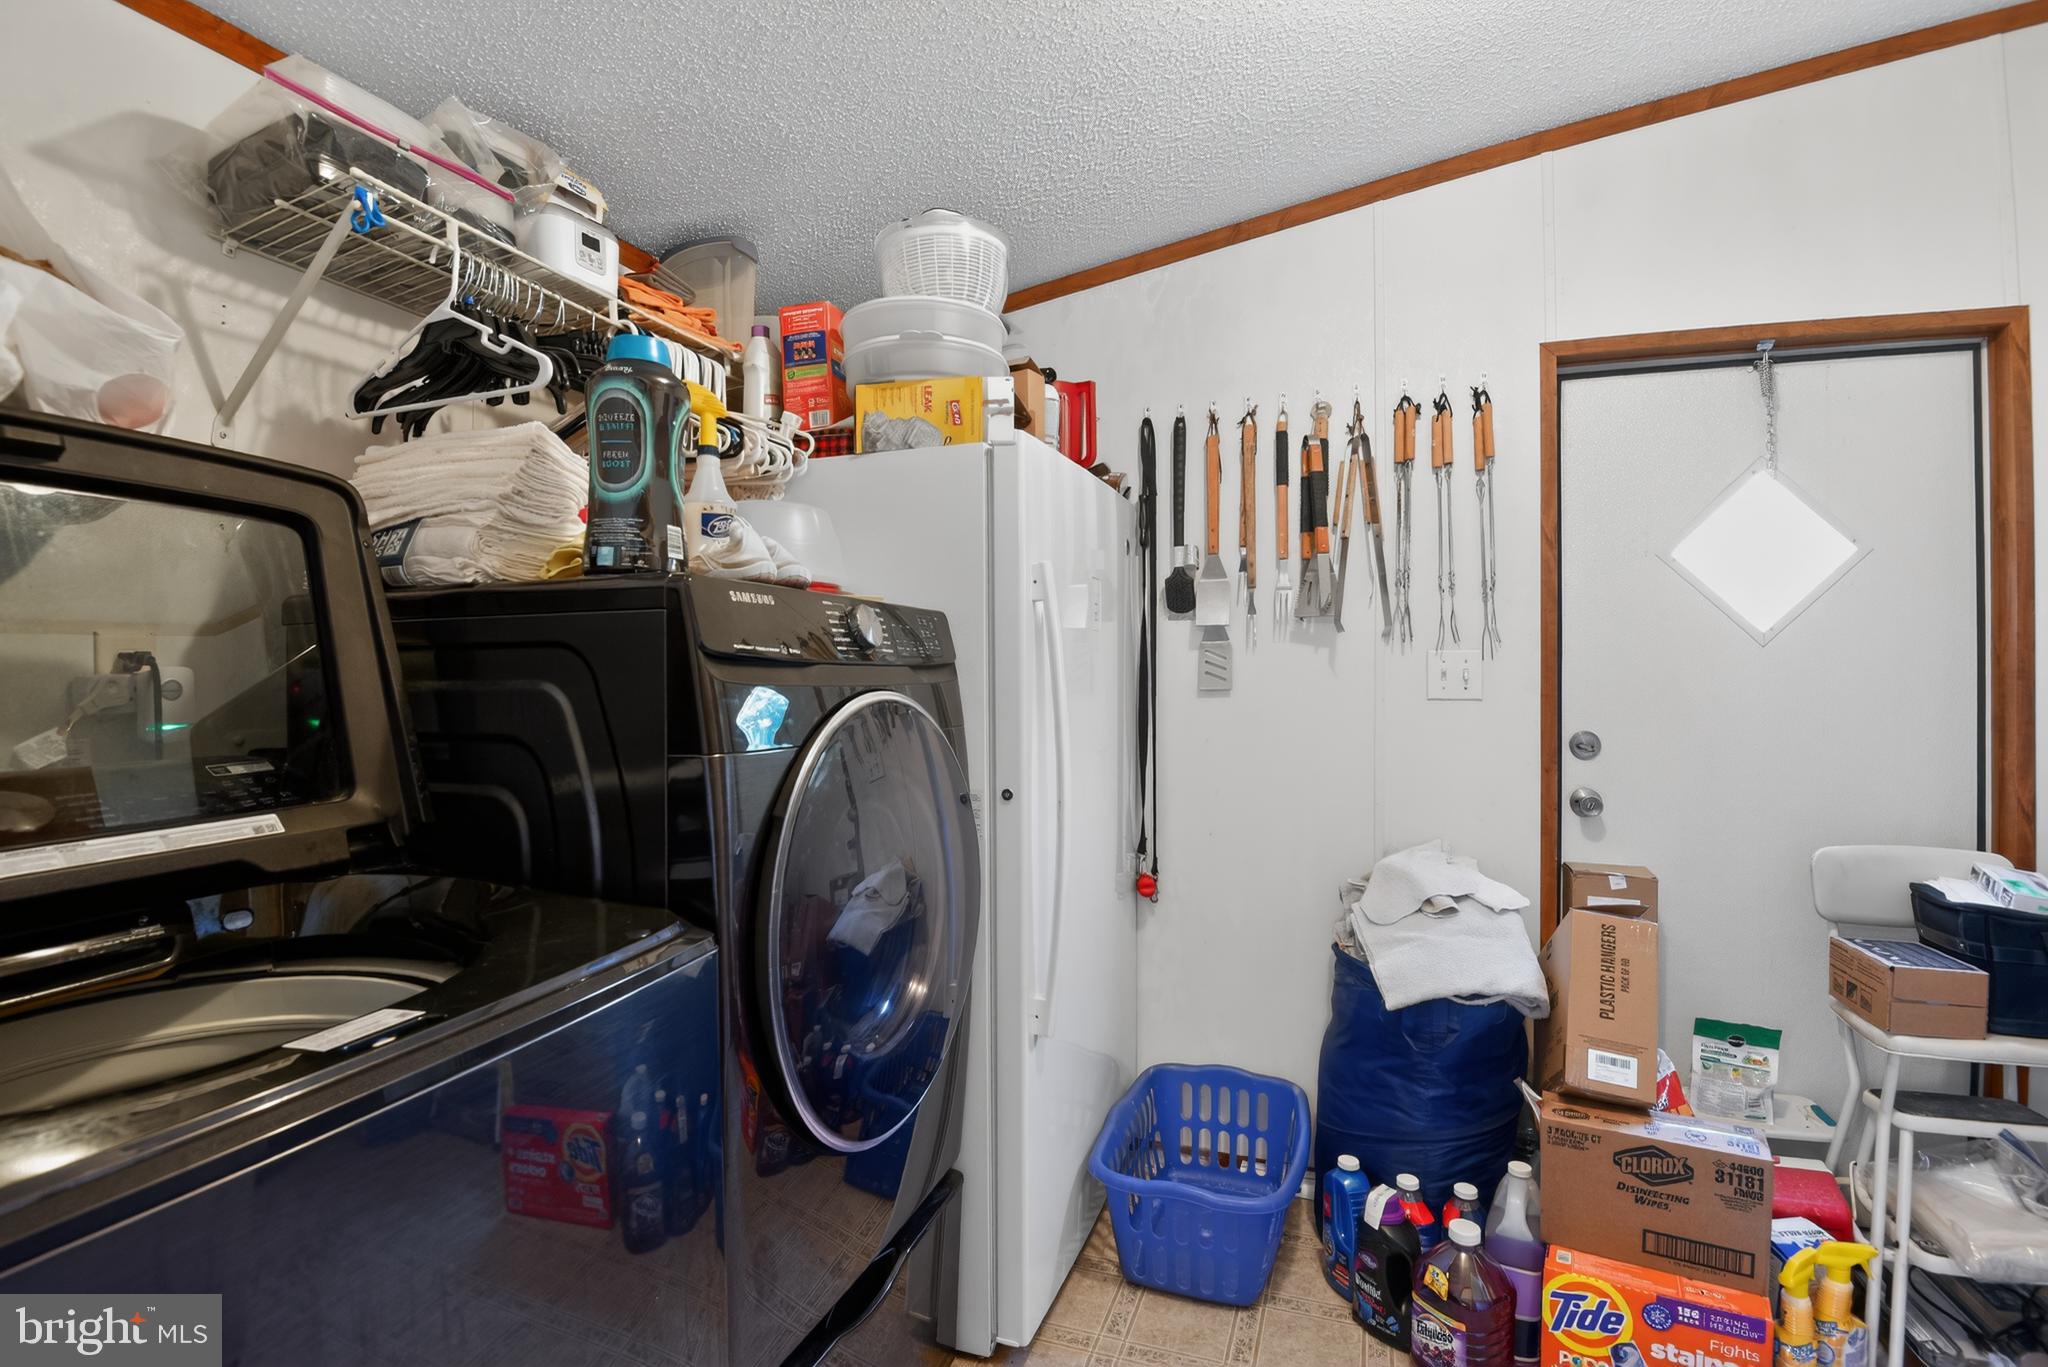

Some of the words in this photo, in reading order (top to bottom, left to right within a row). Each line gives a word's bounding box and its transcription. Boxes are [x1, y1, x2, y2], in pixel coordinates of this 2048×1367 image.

[729, 590, 775, 606] SAMSUNG
[1600, 923, 1617, 974] HANGERS
[1599, 974, 1616, 1021] PLASTIC
[1620, 1156, 1688, 1176] CLOROX
[1714, 1168, 1765, 1193] 31181
[1616, 1181, 1690, 1206] DISINFECTING
[1549, 1289, 1626, 1334] Tide
[1710, 1314, 1750, 1330] SPRING
[1709, 1339, 1760, 1362] Fights
